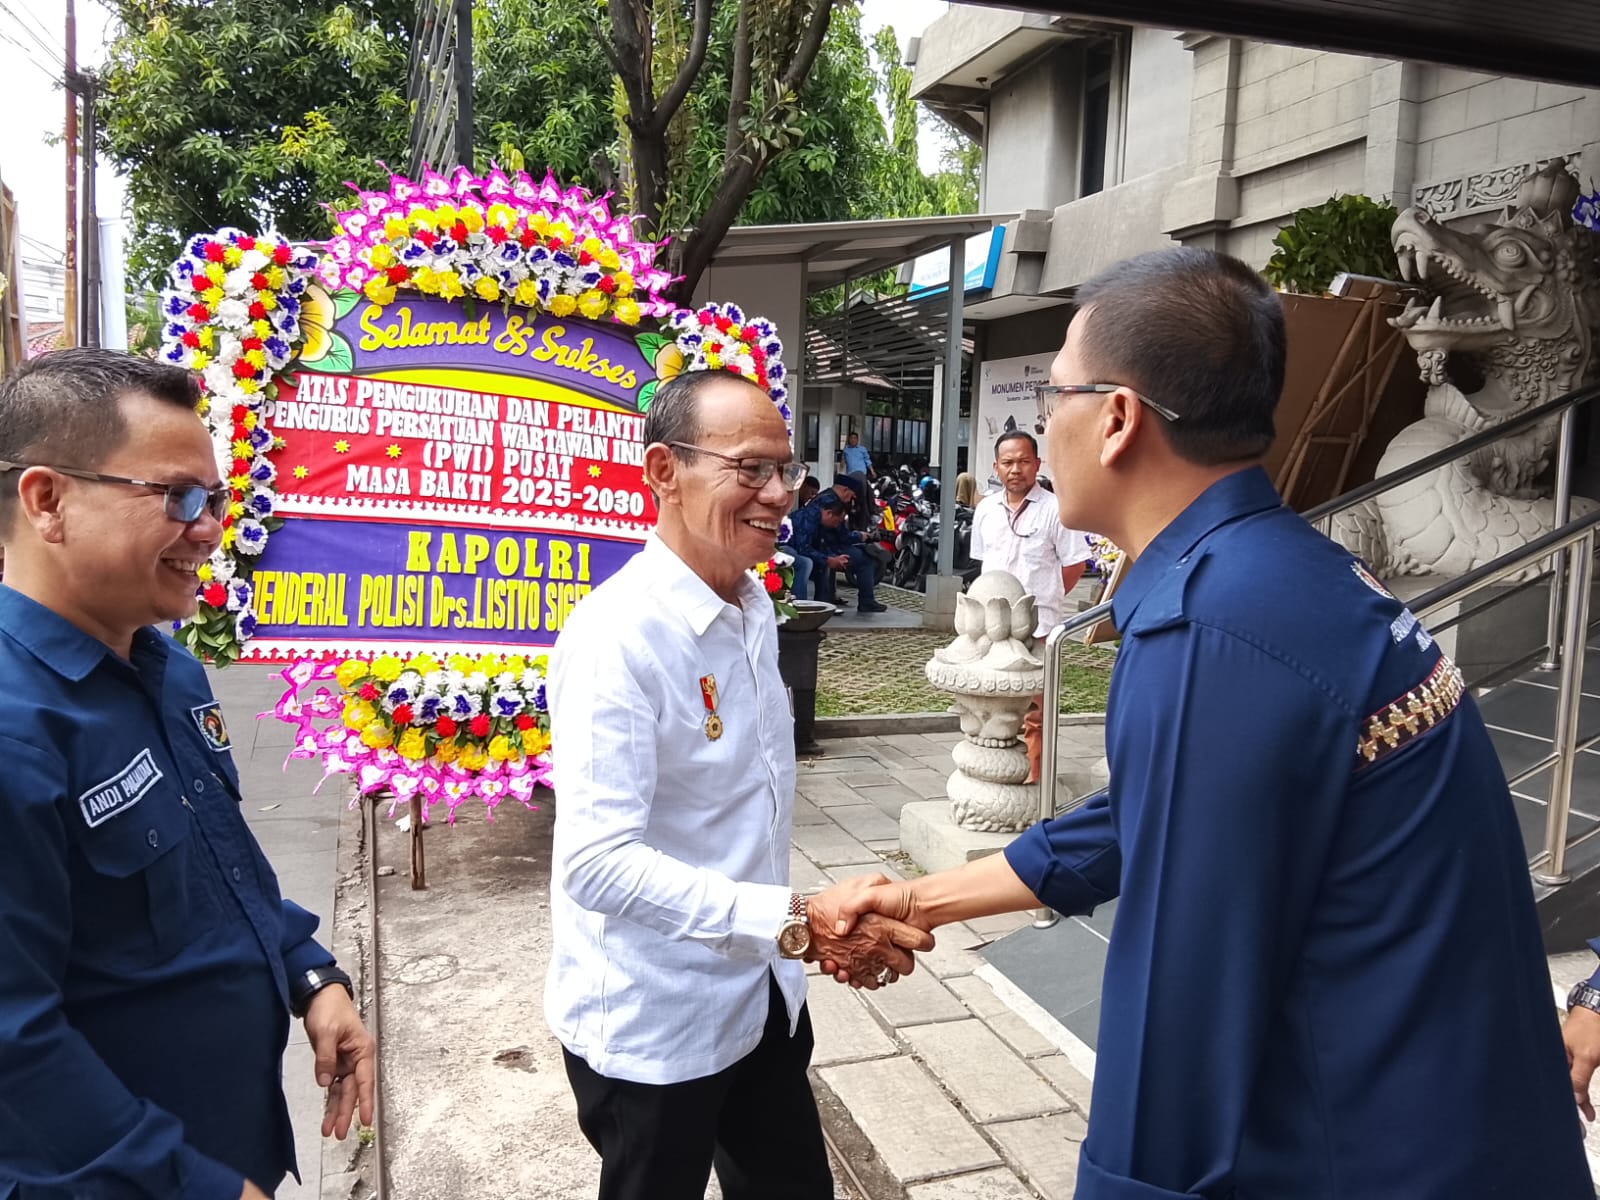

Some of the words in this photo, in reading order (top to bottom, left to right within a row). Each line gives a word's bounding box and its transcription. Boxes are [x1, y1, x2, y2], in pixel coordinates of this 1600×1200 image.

[359, 304, 491, 351] Selamat
[493, 315, 534, 356] &
[531, 325, 637, 389] Sukses
[296, 374, 350, 405] ATAS
[355, 379, 500, 420] PENGUKUHAN
[506, 397, 550, 427] DAN
[991, 381, 1024, 395] MONUMEN
[258, 399, 372, 434] PENGURUS
[376, 409, 495, 446] PERSATUAN
[500, 422, 609, 461] WARTAWAN
[423, 440, 495, 473] (PWI)
[503, 448, 574, 480] PUSAT
[345, 464, 411, 495] MASA
[419, 470, 492, 502] BAKTI
[501, 476, 645, 517] 2025-2030
[405, 531, 591, 582] KAPOLRI
[252, 570, 348, 626] JENDERAL
[358, 574, 425, 627] POLISI
[545, 582, 592, 632] SIG
[88, 785, 123, 816] ANDI
